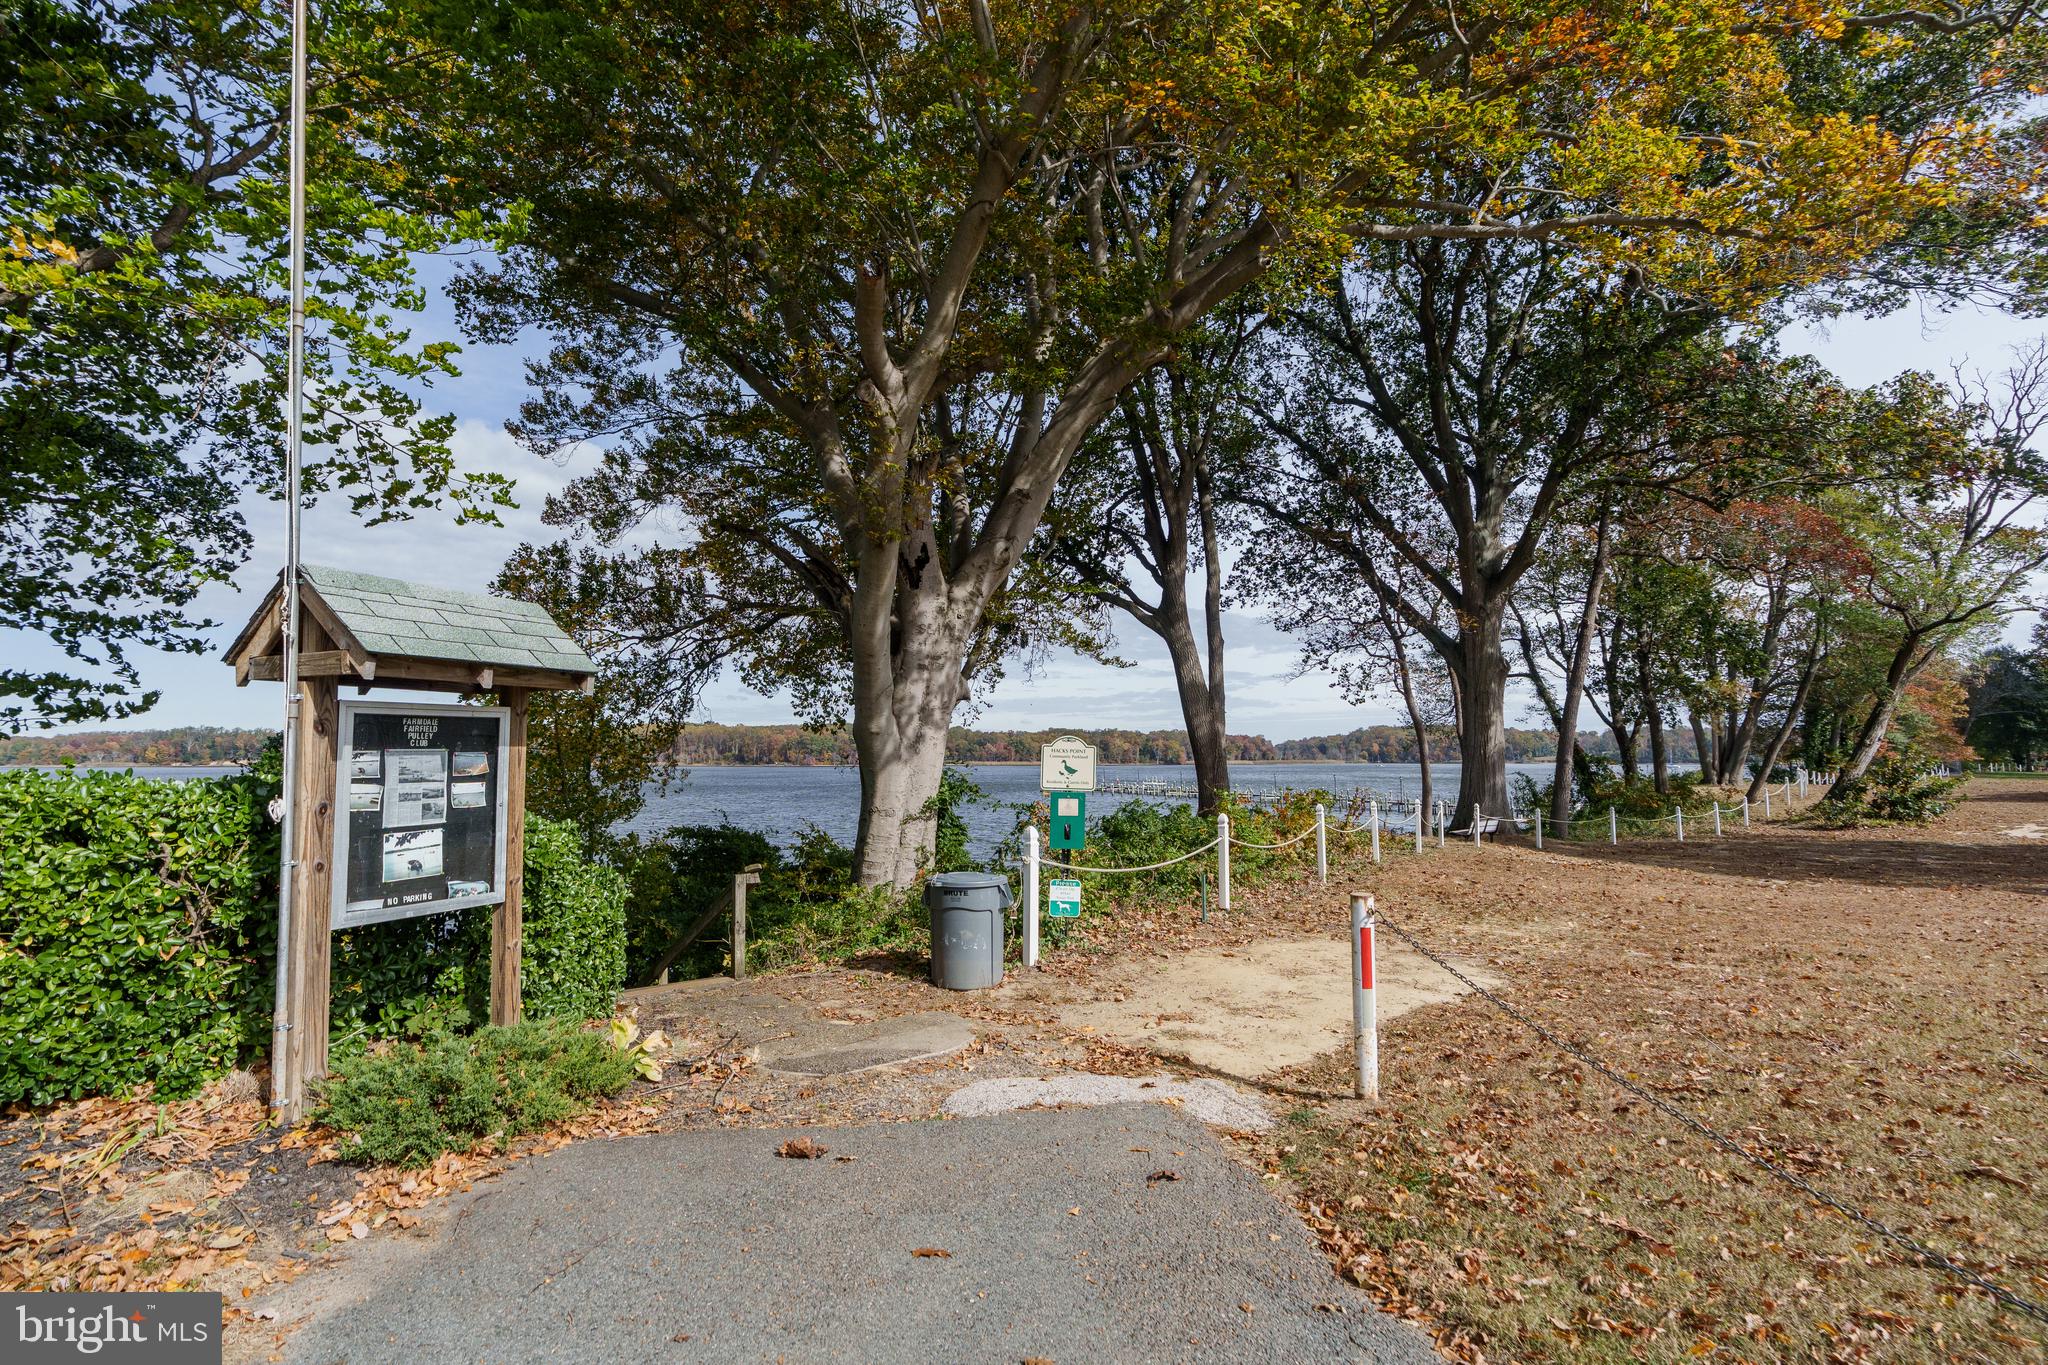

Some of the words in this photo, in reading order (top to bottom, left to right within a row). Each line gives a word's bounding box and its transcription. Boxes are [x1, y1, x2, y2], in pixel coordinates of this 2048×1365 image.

[410, 739, 428, 747] CLUB
[387, 897, 398, 906] NO
[403, 892, 433, 903] PARKING
